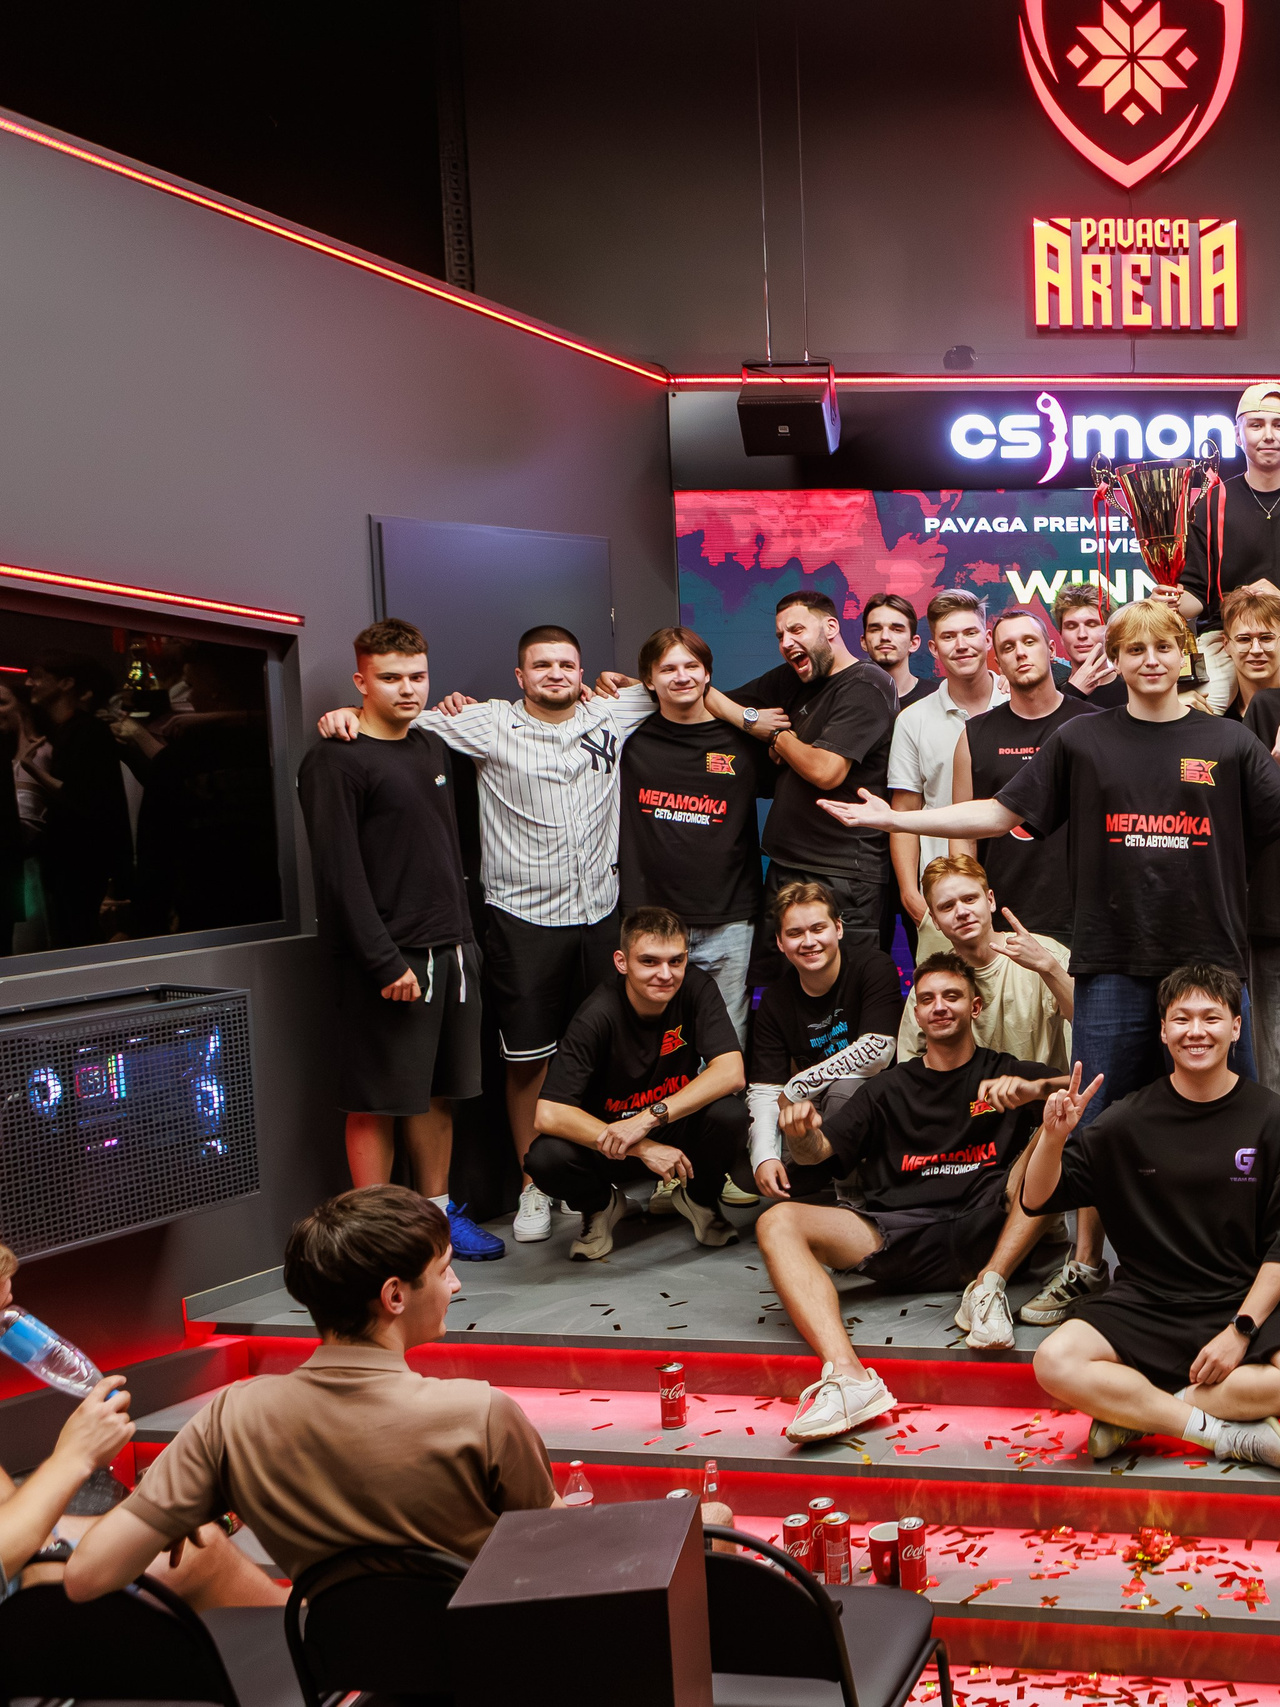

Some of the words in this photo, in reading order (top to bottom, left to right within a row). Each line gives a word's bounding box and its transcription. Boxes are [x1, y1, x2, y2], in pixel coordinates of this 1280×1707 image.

[1081, 218, 1190, 249] PAVAGA
[1033, 217, 1238, 326] ARENA
[924, 516, 1028, 533] PAVAGA
[1080, 538, 1141, 554] DIVIS
[998, 747, 1035, 755] ROLLING
[638, 787, 727, 815] МЕГАМОЙКА
[654, 807, 672, 820] СЕТЬ
[671, 810, 710, 825] АВТОМОЕК
[1105, 811, 1212, 836] МЕГАМОЙКА
[1124, 834, 1146, 848] СЕТЬ
[1145, 835, 1190, 850] АВТОМОЕК
